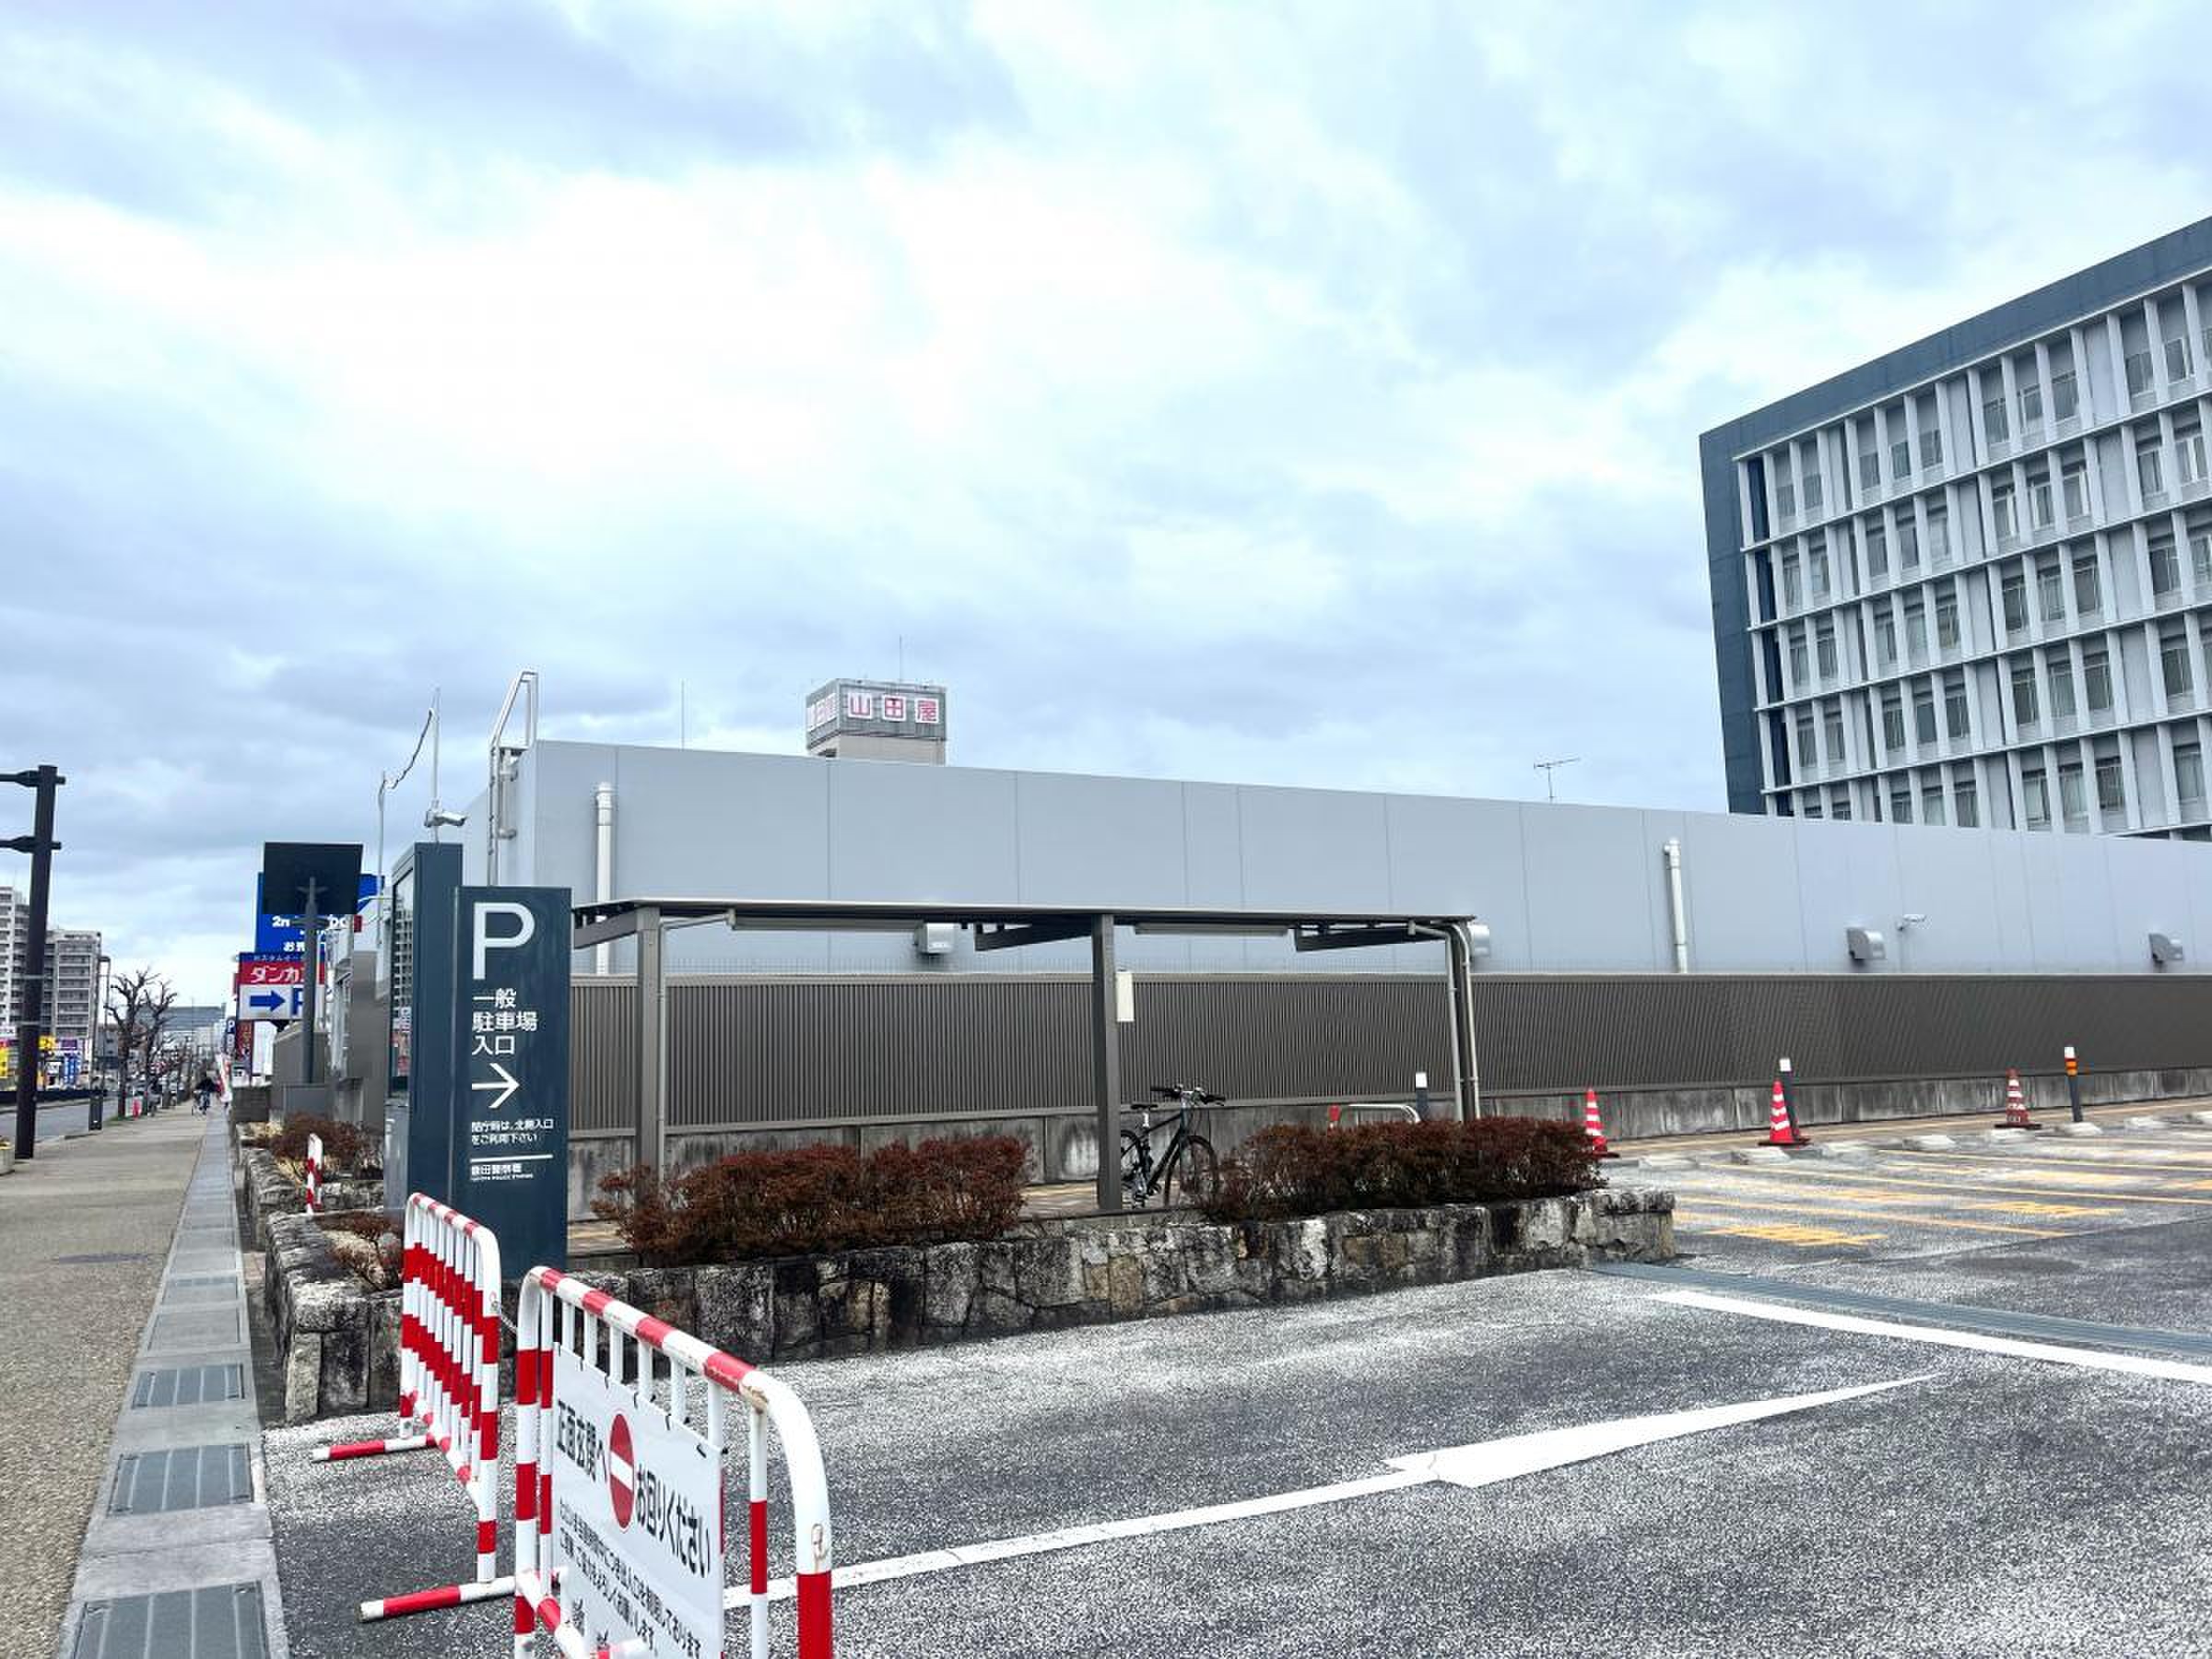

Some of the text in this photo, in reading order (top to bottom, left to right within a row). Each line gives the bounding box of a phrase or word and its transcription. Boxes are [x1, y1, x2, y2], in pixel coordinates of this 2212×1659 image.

[848, 693, 939, 724] 山田屋
[473, 901, 535, 980] P
[472, 987, 517, 1009] 一般
[471, 1011, 538, 1033] 駐車場
[471, 1035, 516, 1055] 入口
[635, 1463, 711, 1579] お回りください
